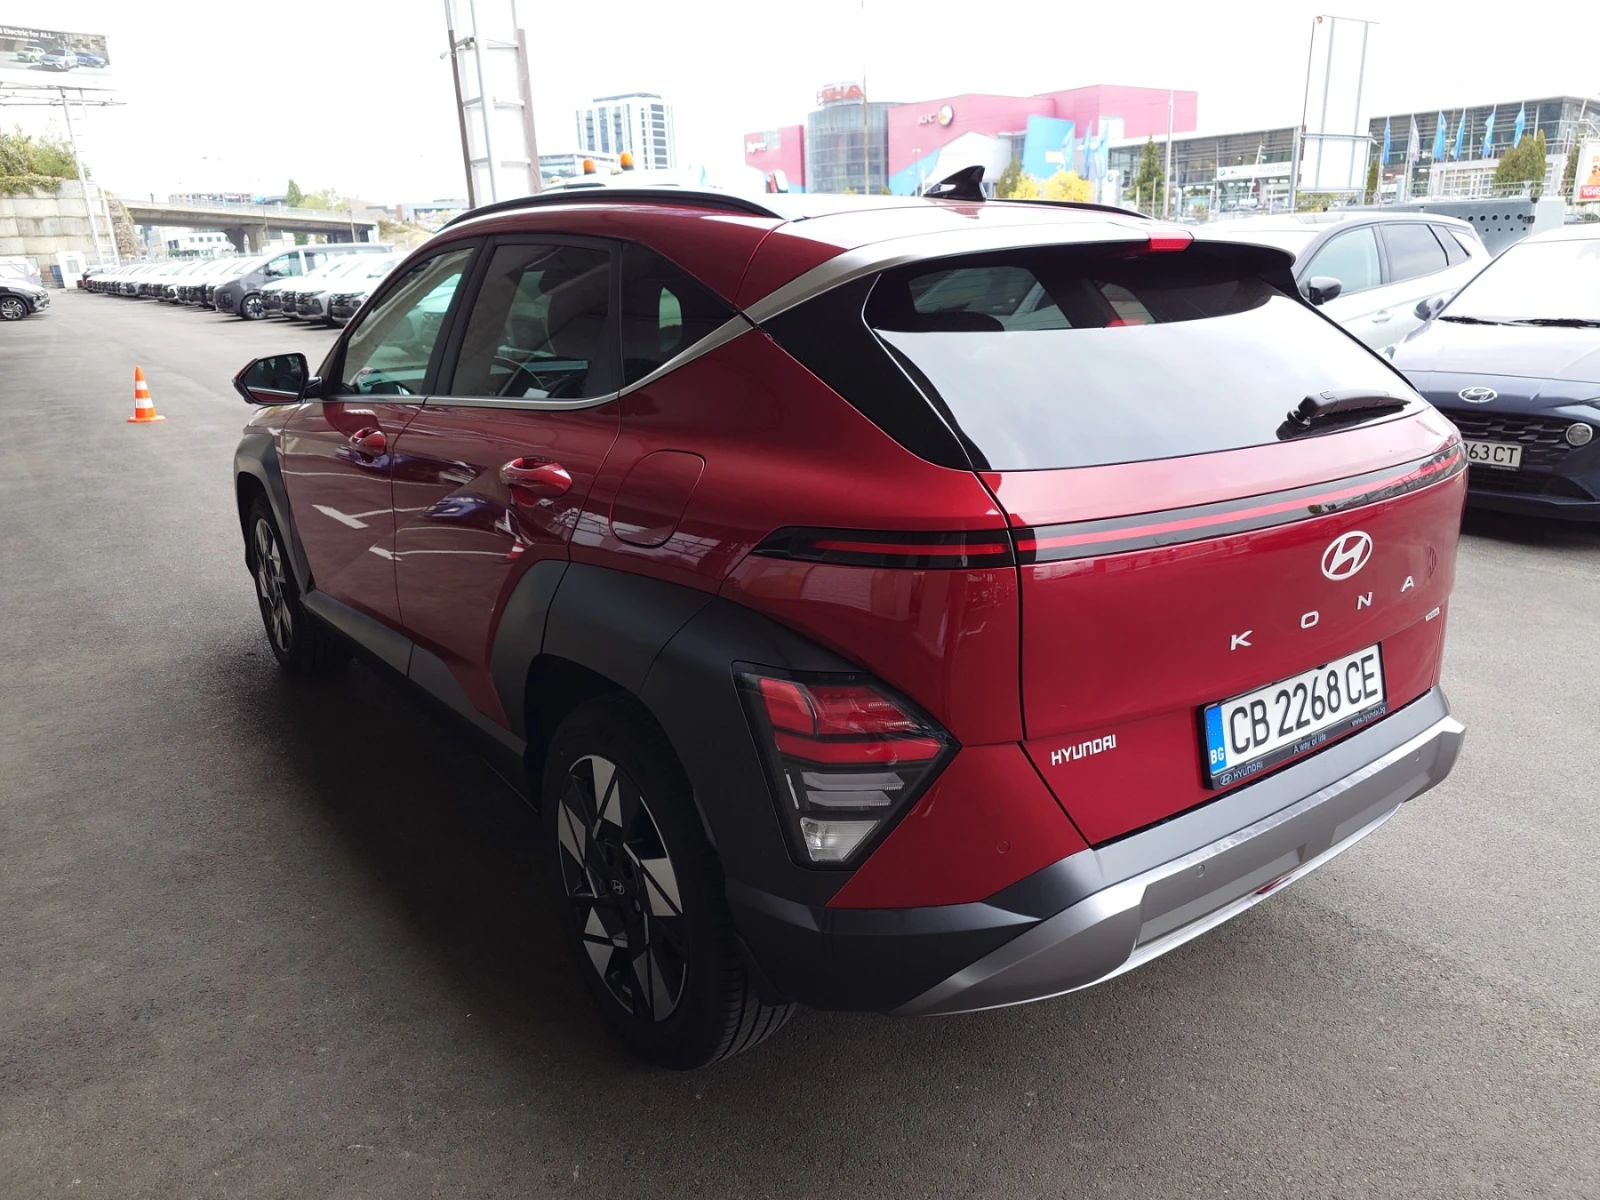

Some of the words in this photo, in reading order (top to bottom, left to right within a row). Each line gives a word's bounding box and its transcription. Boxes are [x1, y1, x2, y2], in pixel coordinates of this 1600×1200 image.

[1493, 446, 1518, 463] CT
[1229, 699, 1270, 755] CB
[1275, 670, 1342, 737] 2268
[1345, 653, 1379, 705] CE
[1051, 733, 1117, 766] HYUNDAI
[1210, 747, 1225, 765] BG
[1233, 761, 1263, 780] HYUNDAI
[1293, 745, 1299, 754] A
